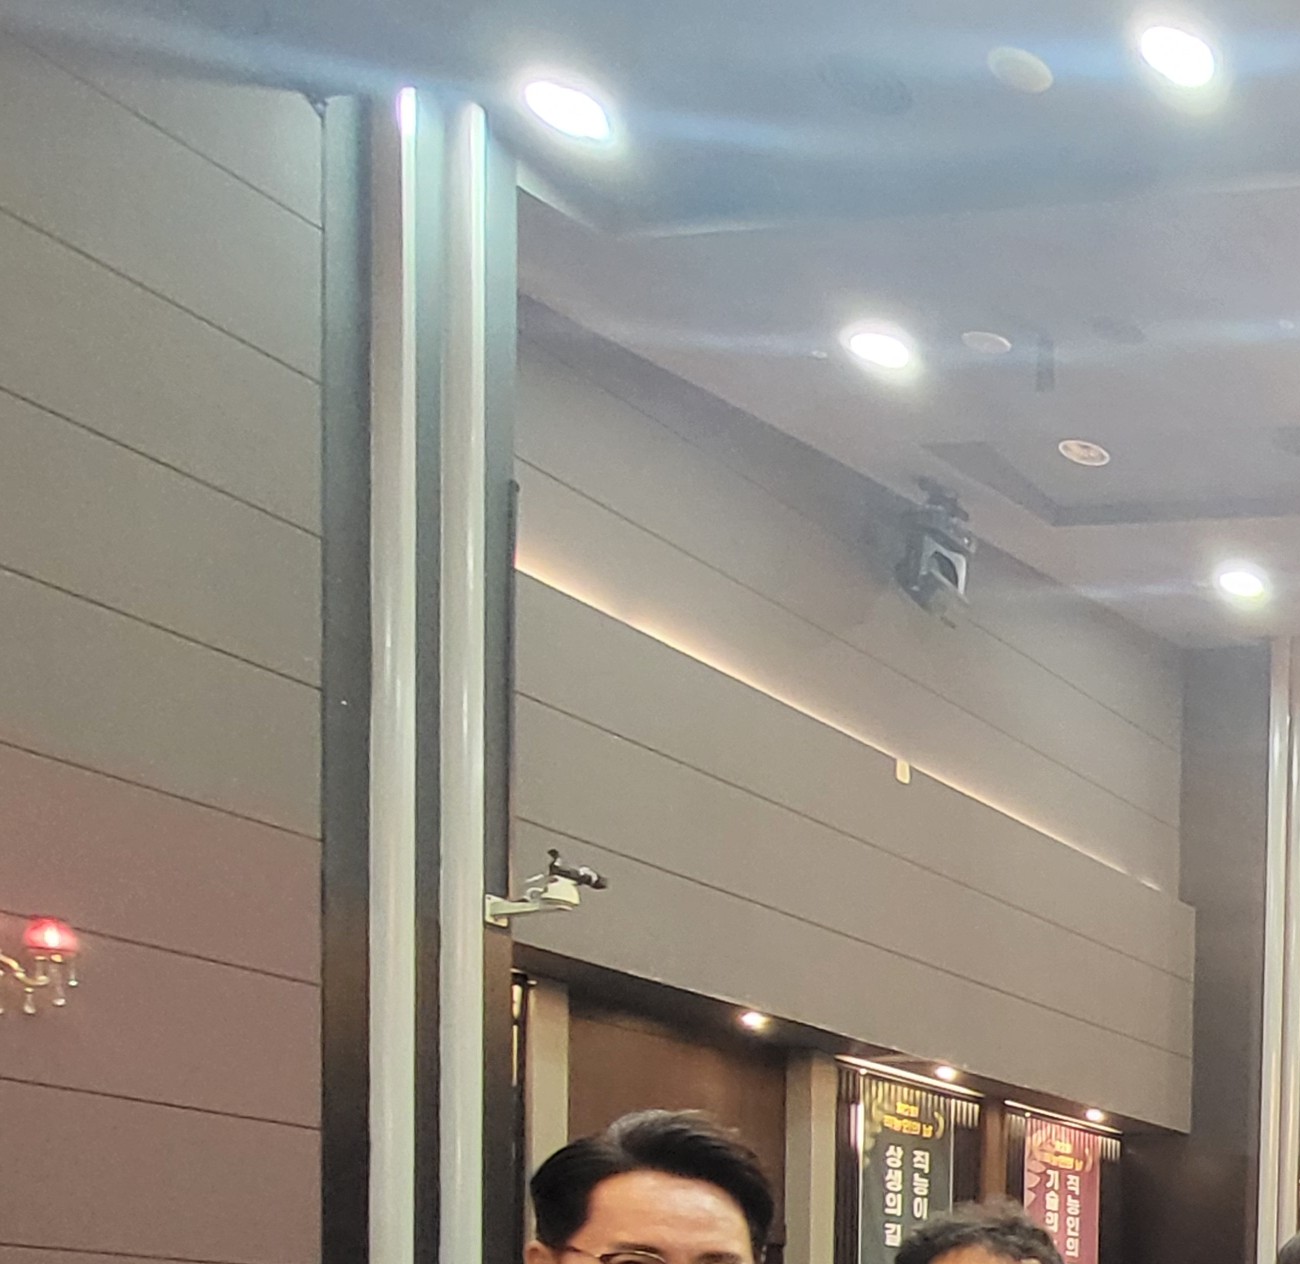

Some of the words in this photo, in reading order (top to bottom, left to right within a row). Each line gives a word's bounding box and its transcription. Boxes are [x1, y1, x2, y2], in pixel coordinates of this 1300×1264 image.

[884, 1145, 904, 1217] 상생의
[1065, 1174, 1080, 1257] 직능인의
[884, 1223, 902, 1247] 길
